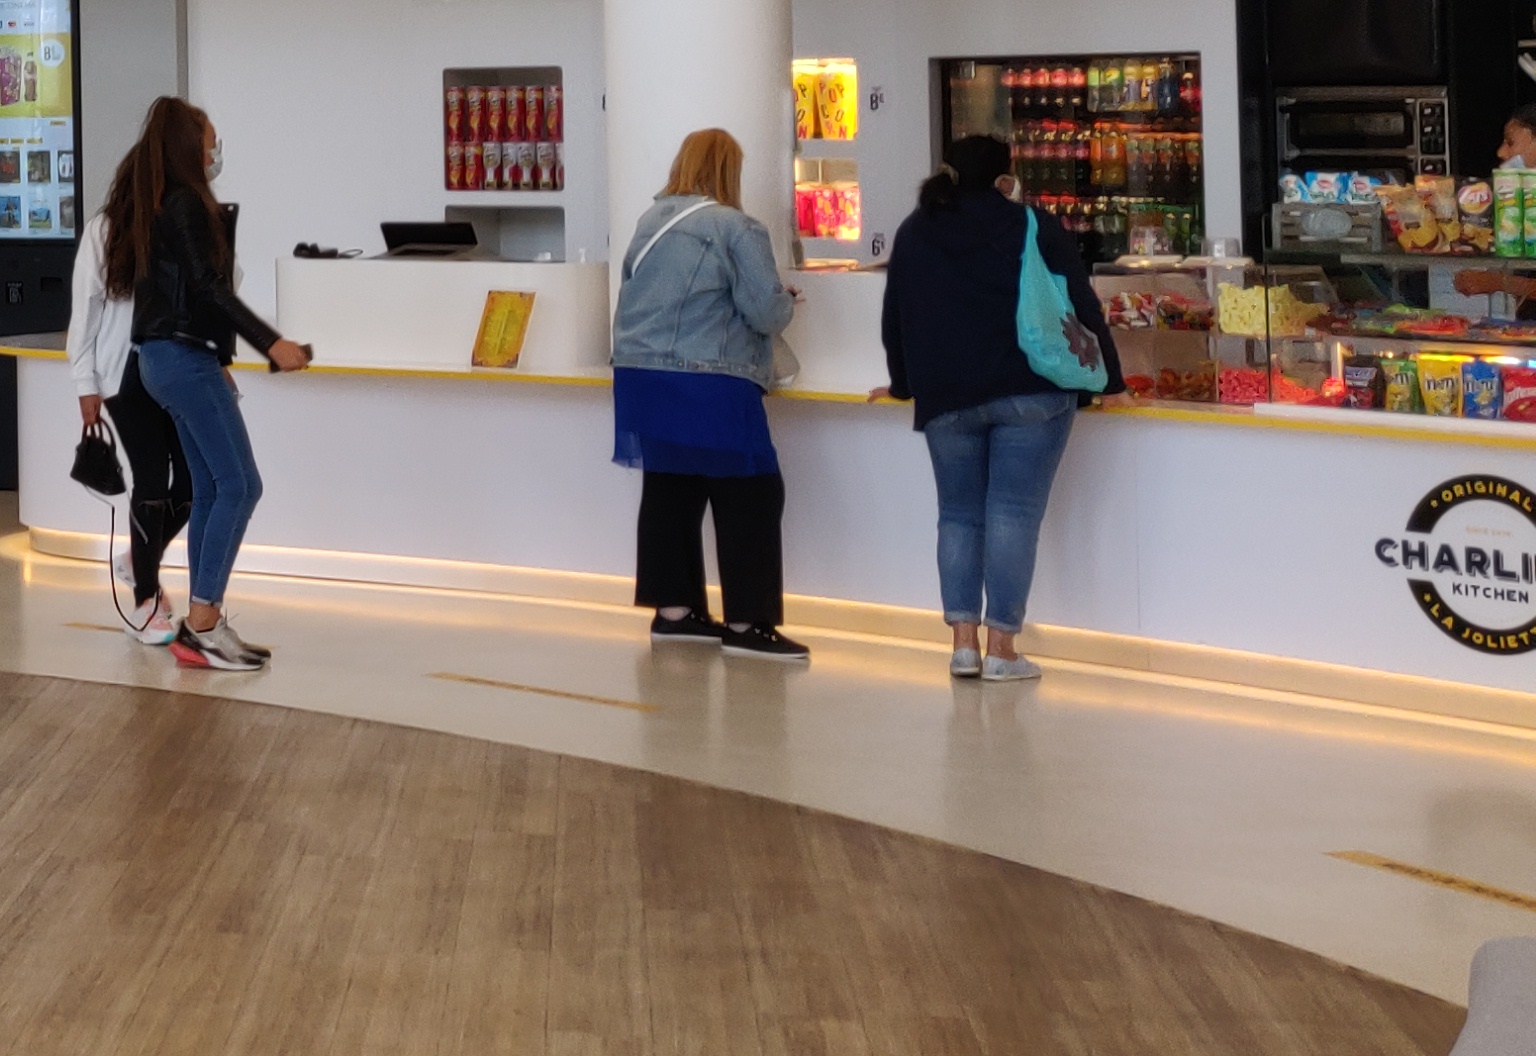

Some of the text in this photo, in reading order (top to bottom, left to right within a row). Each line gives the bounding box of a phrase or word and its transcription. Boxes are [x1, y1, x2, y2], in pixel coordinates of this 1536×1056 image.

[1441, 480, 1533, 512] ORIGINAL
[1374, 537, 1536, 585] CHARLI
[1452, 582, 1530, 604] KITCHEN
[1429, 602, 1455, 630] LA
